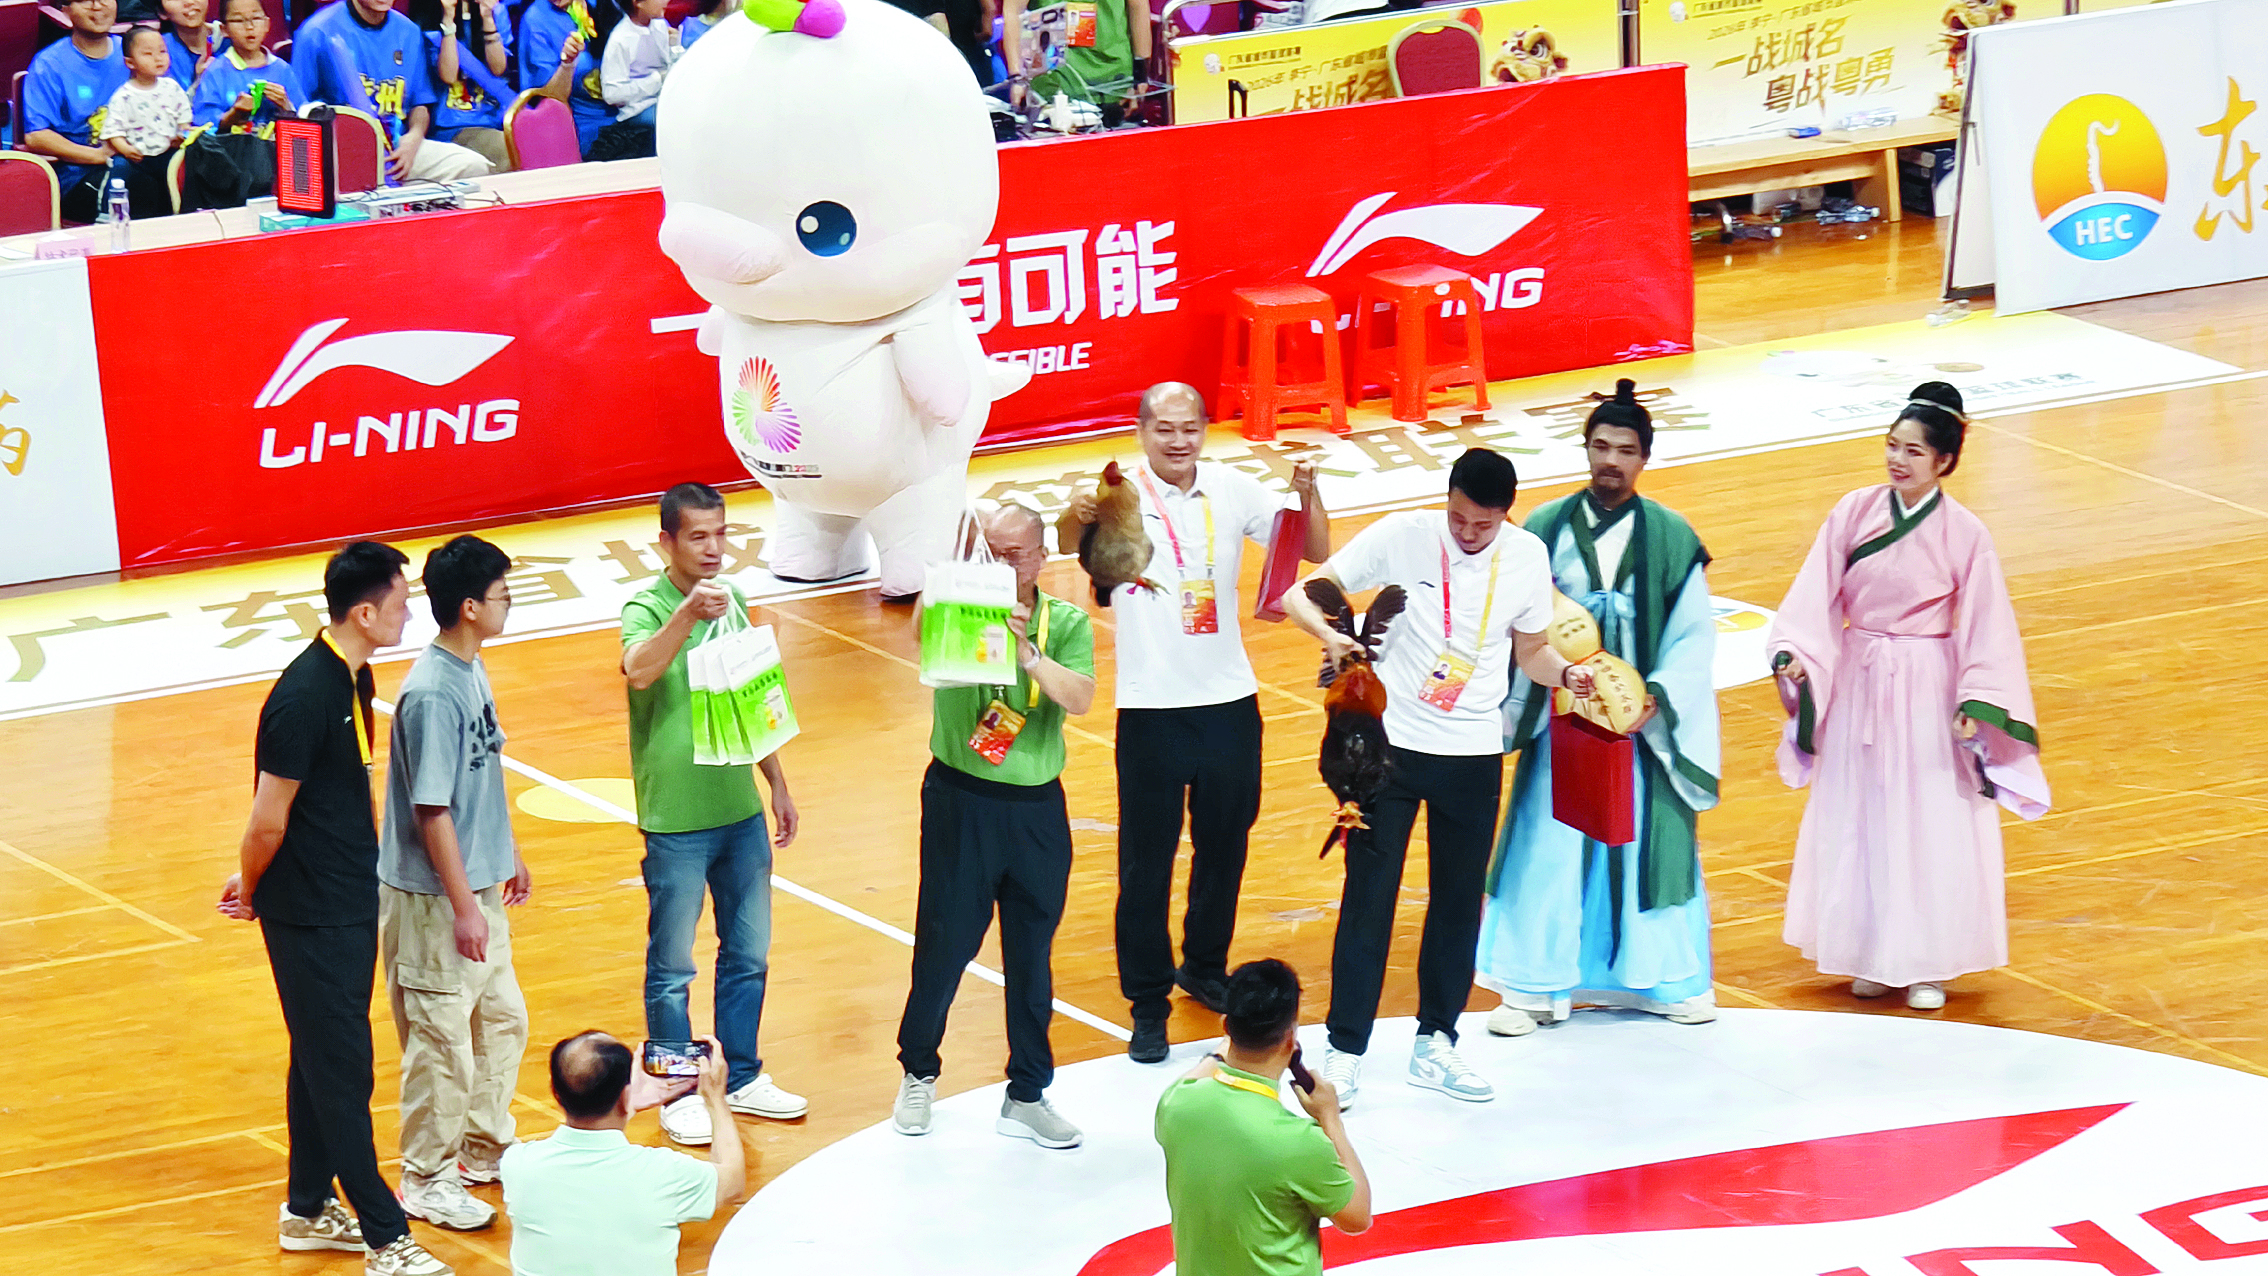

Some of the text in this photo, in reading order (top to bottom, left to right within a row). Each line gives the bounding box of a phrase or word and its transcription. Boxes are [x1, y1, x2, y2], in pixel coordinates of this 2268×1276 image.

[1762, 47, 1896, 117] 粤战粤勇
[2193, 75, 2268, 242] 东
[2075, 213, 2134, 246] HEC
[259, 398, 521, 469] LI-NING
